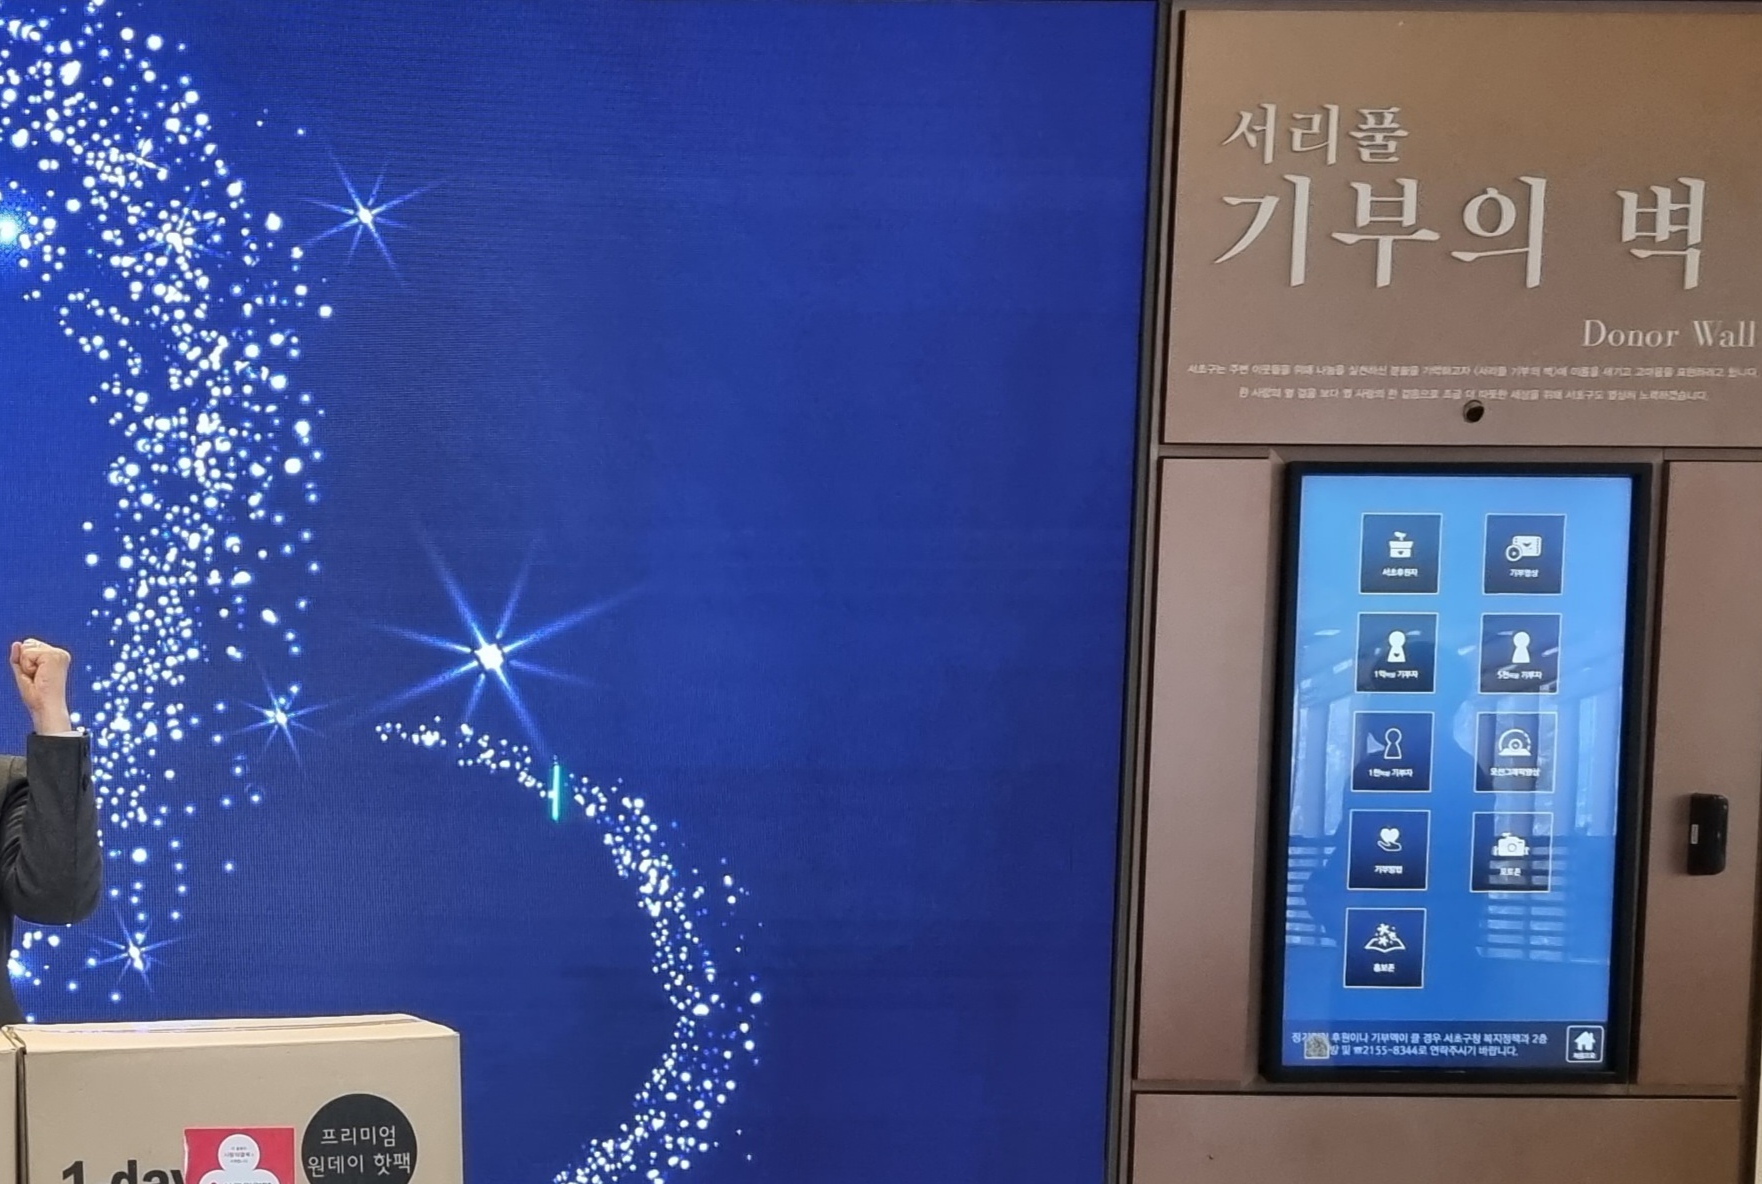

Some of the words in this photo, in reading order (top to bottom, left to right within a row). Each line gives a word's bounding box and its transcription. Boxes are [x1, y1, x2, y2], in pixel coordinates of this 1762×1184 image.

[1223, 104, 1409, 165] 서리풀
[1215, 175, 1547, 289] 기부의
[1616, 177, 1706, 290] 벽
[1582, 319, 1680, 349] Donor
[1693, 320, 1757, 349] Wall
[1332, 1032, 1368, 1043] 후원이나
[1423, 1033, 1441, 1044] 경우
[1443, 1033, 1481, 1044] 서초구청
[320, 1126, 396, 1146] 프리미엄
[307, 1155, 365, 1176] 원데이
[373, 1154, 411, 1175] 핫팩
